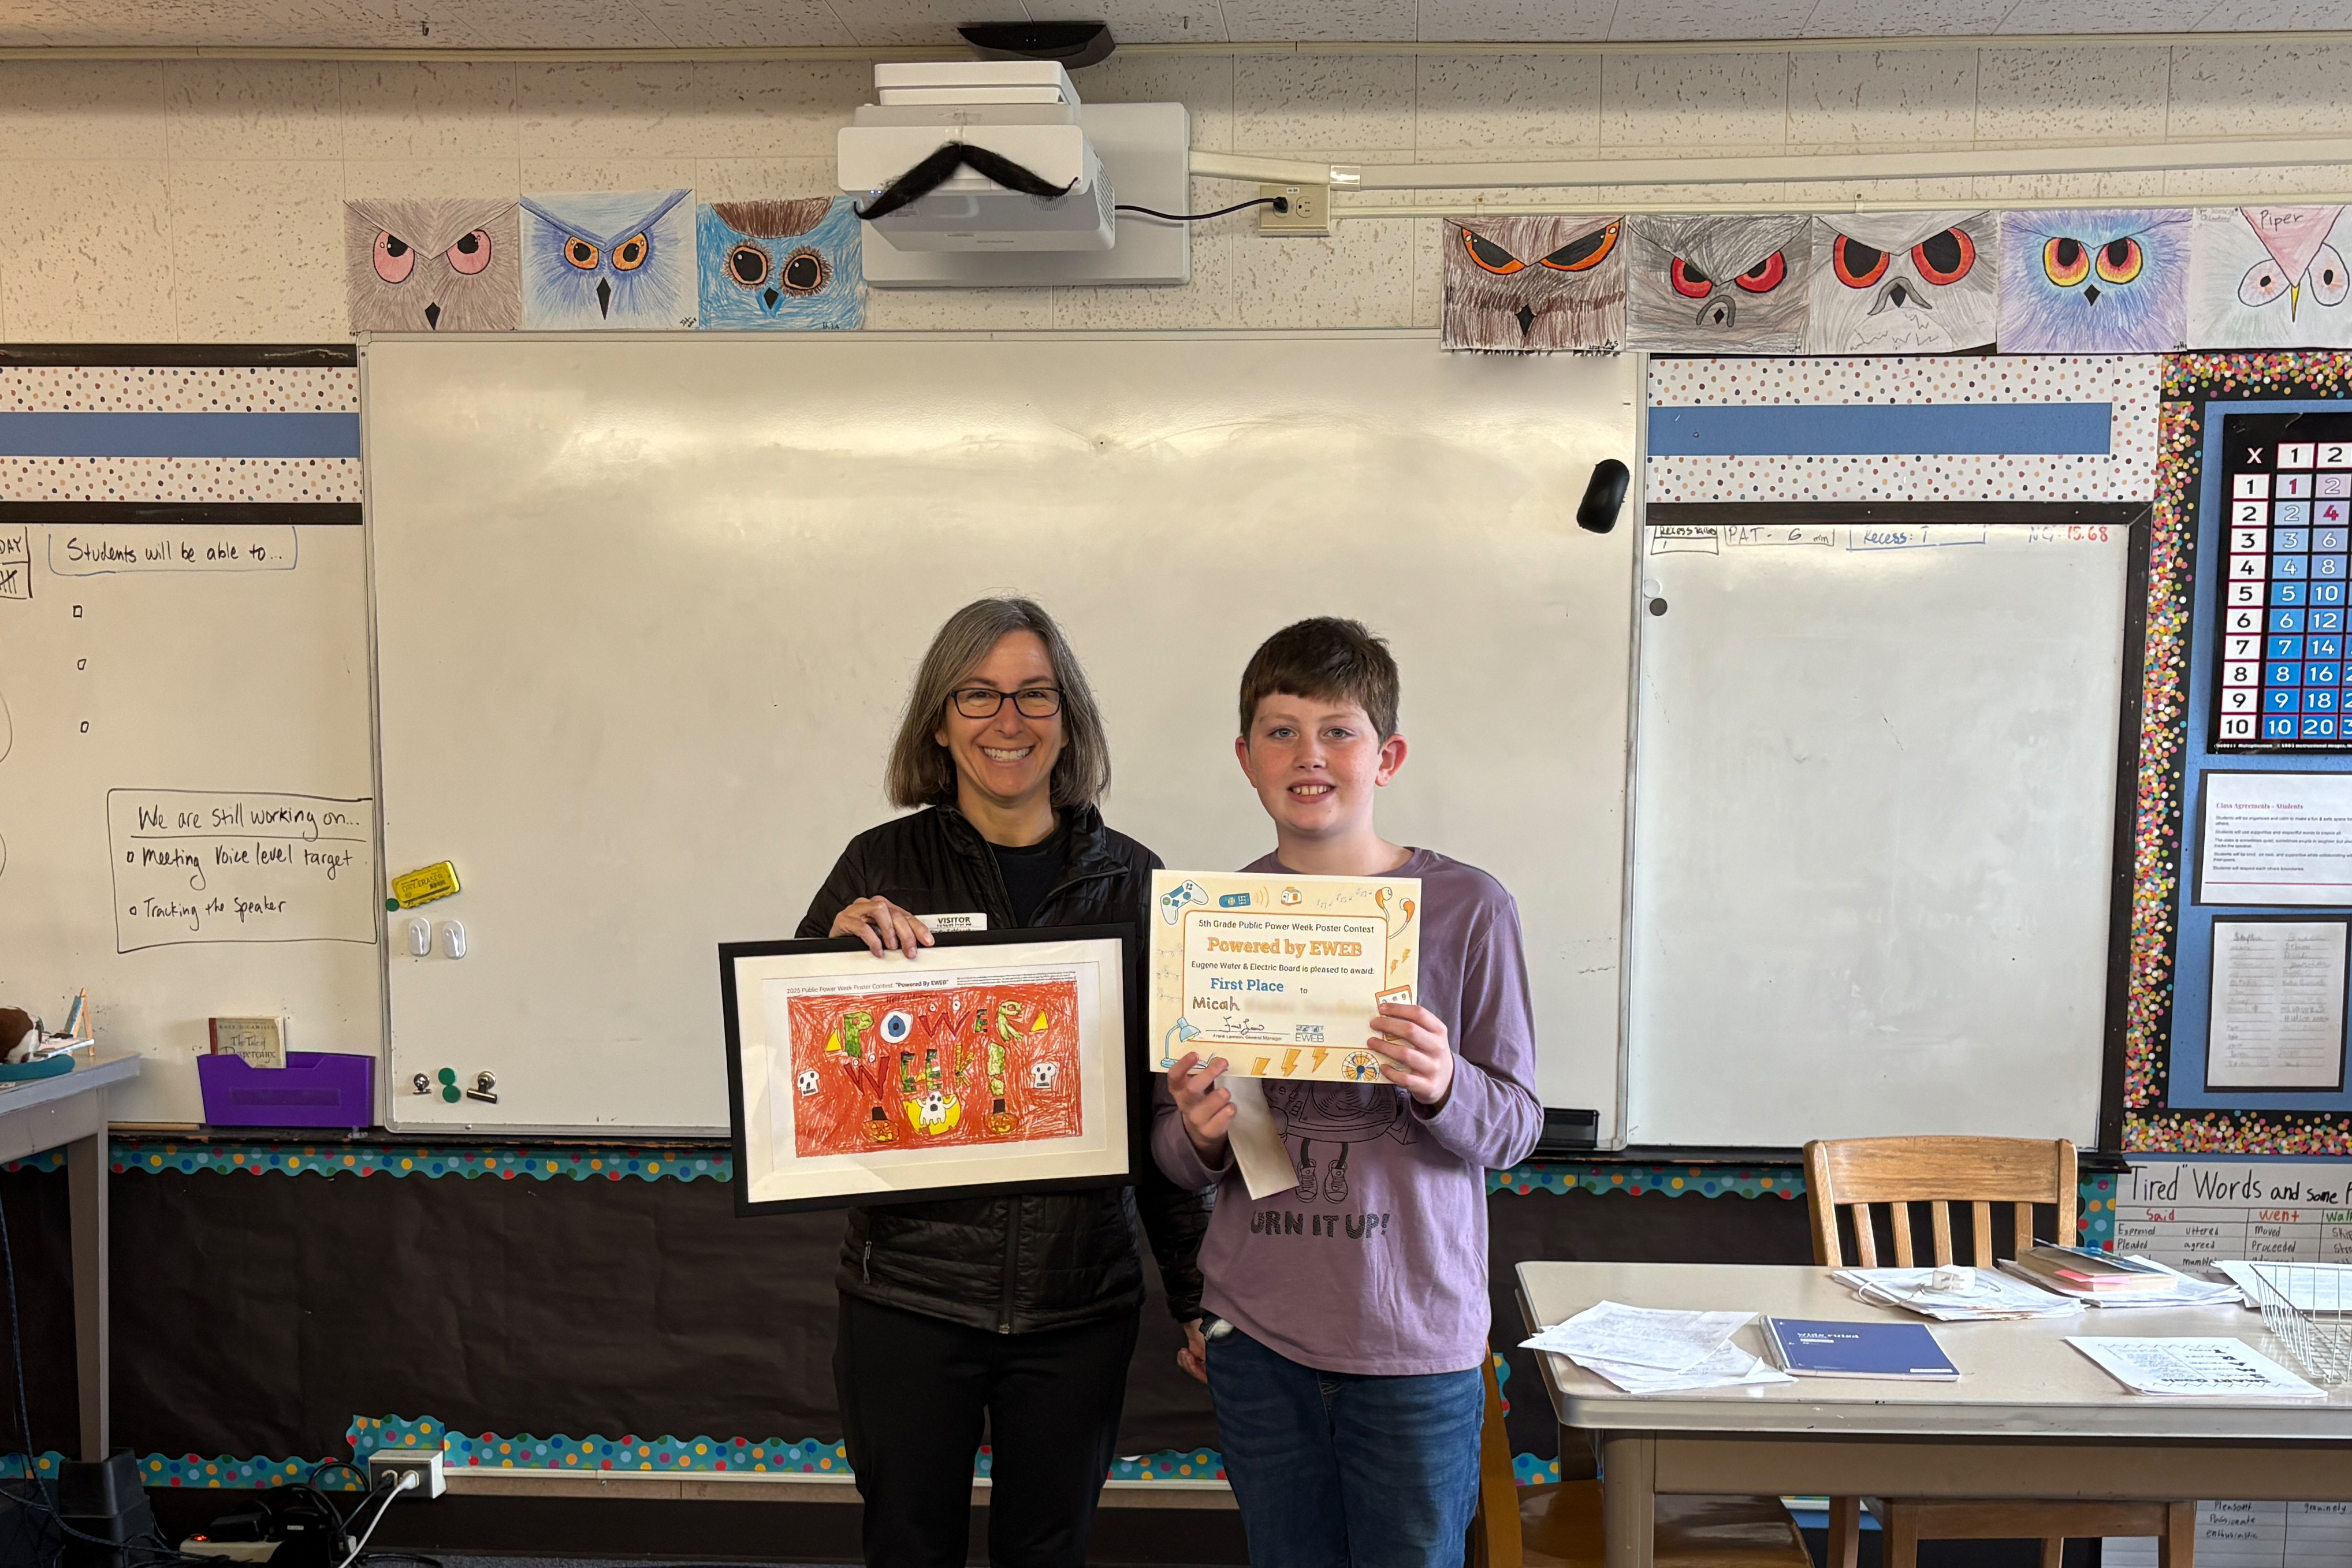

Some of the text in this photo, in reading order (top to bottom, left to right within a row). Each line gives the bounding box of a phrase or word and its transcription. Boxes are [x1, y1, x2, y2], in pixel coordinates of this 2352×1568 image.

[2260, 210, 2304, 232] Piper
[2291, 448, 2299, 463] 1
[2328, 447, 2343, 462] 2
[2247, 478, 2341, 494] 1 1 2
[2242, 505, 2339, 522] 2 2 4
[1729, 526, 1765, 545] PAT
[2067, 526, 2108, 542] 15.68
[2241, 532, 2337, 548] 3 3 6
[68, 538, 136, 563] Students
[146, 541, 171, 561] will
[182, 541, 195, 563] be
[207, 541, 239, 559] able
[2240, 558, 2336, 575] 4 4 8
[2239, 586, 2339, 601] 5 5 10
[2237, 612, 2337, 628] 6 6 12
[2236, 640, 2335, 655] 7 7 14
[2234, 666, 2248, 681] 8
[2276, 666, 2290, 682] 8
[2310, 666, 2334, 681] 16
[2232, 693, 2246, 709] 9
[2275, 693, 2289, 709] 9
[2308, 693, 2332, 709] 18
[2225, 719, 2249, 734] 10
[2269, 719, 2292, 734] 10
[2303, 720, 2334, 734] 20
[139, 805, 168, 830] We
[179, 813, 202, 828] are
[251, 807, 318, 841] working
[256, 842, 292, 864] level
[304, 849, 353, 880] target
[417, 873, 443, 887] ERASER
[144, 897, 199, 931] Tracking
[206, 897, 224, 912] the
[1199, 919, 1211, 928] 5th
[1292, 923, 1313, 931] Week
[1315, 924, 1341, 932] Poster
[1344, 925, 1374, 933] Contest
[1207, 937, 1362, 958] Powered by EWEB
[1191, 961, 1218, 971] Eugene
[1250, 963, 1277, 971] Electric
[1279, 964, 1300, 972] Board
[1310, 966, 1339, 975] pleased
[1211, 978, 1243, 992] First
[1246, 979, 1284, 992] Place
[1193, 996, 1240, 1012] Micah
[843, 1000, 1024, 1058] POWER
[231, 1034, 244, 1046] The
[1296, 1033, 1324, 1042] EWEB
[2193, 1168, 2262, 1201] Words
[2271, 1182, 2300, 1201] and
[2146, 1209, 2175, 1221] Said
[1313, 1215, 1339, 1238] IT
[1345, 1213, 1390, 1239] UP!
[2184, 1241, 2215, 1252] agreed
[2251, 1241, 2296, 1253] Proceeded
